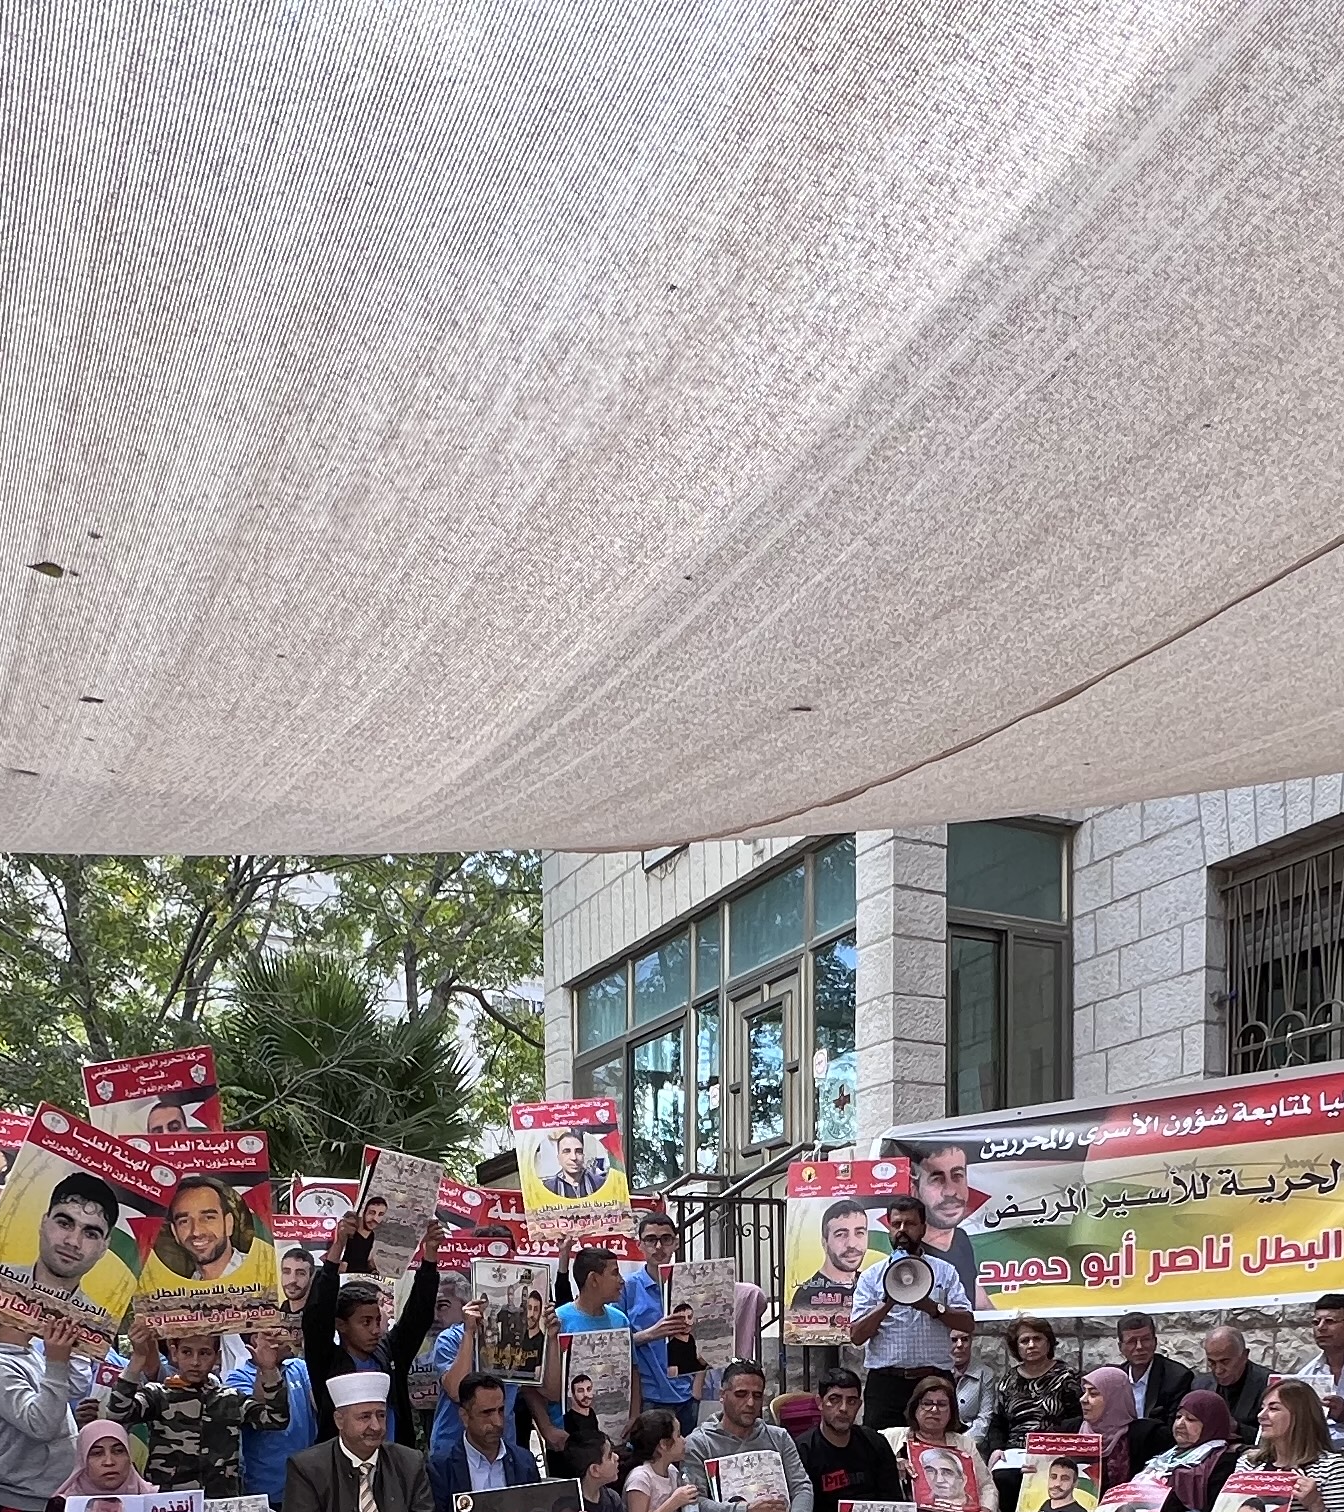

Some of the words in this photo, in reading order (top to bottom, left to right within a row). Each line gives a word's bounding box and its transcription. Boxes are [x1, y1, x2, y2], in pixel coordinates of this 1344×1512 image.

[1161, 1105, 1228, 1137] شؤون
[1232, 1094, 1310, 1124] لمتابعة
[72, 1126, 113, 1152] العليا
[155, 1141, 194, 1155] العليا
[197, 1140, 234, 1154] الهيئة
[978, 1124, 1075, 1162] والمحررين
[1076, 1113, 1159, 1149] الأسرى
[113, 1141, 150, 1172] الهيئة
[983, 1188, 1089, 1229] المريض
[1095, 1171, 1210, 1218] للأسير
[1082, 1230, 1137, 1287] أبو
[1148, 1234, 1234, 1283] ناصر
[1242, 1229, 1343, 1276] البطل
[976, 1253, 1071, 1294] حميد
